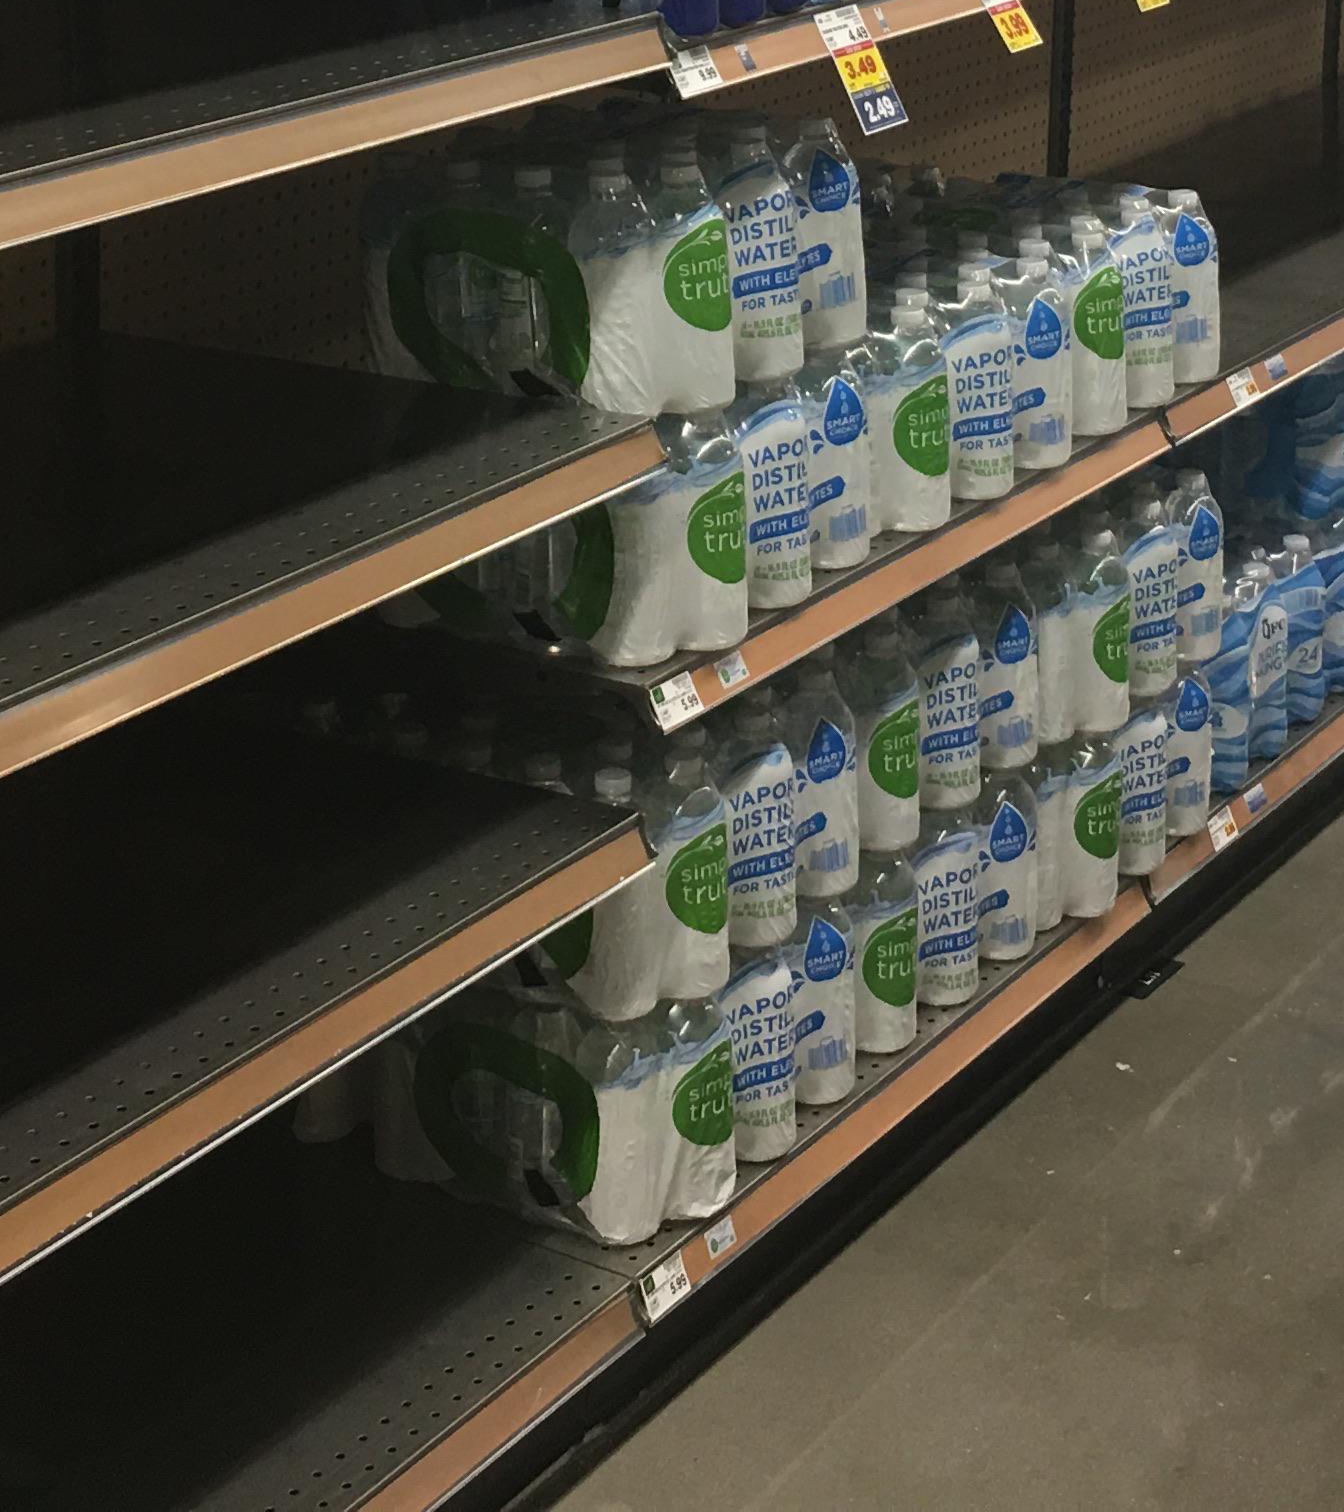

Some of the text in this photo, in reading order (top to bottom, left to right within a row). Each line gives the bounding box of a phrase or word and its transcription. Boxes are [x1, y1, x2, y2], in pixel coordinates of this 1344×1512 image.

[845, 55, 877, 79] 3.49
[863, 95, 895, 123] 2.49
[730, 217, 795, 246] DISTIL
[678, 255, 728, 277] simp
[679, 277, 730, 301] trut
[739, 275, 771, 292] WITH
[741, 296, 766, 312] FOR
[1298, 646, 1319, 665] 24
